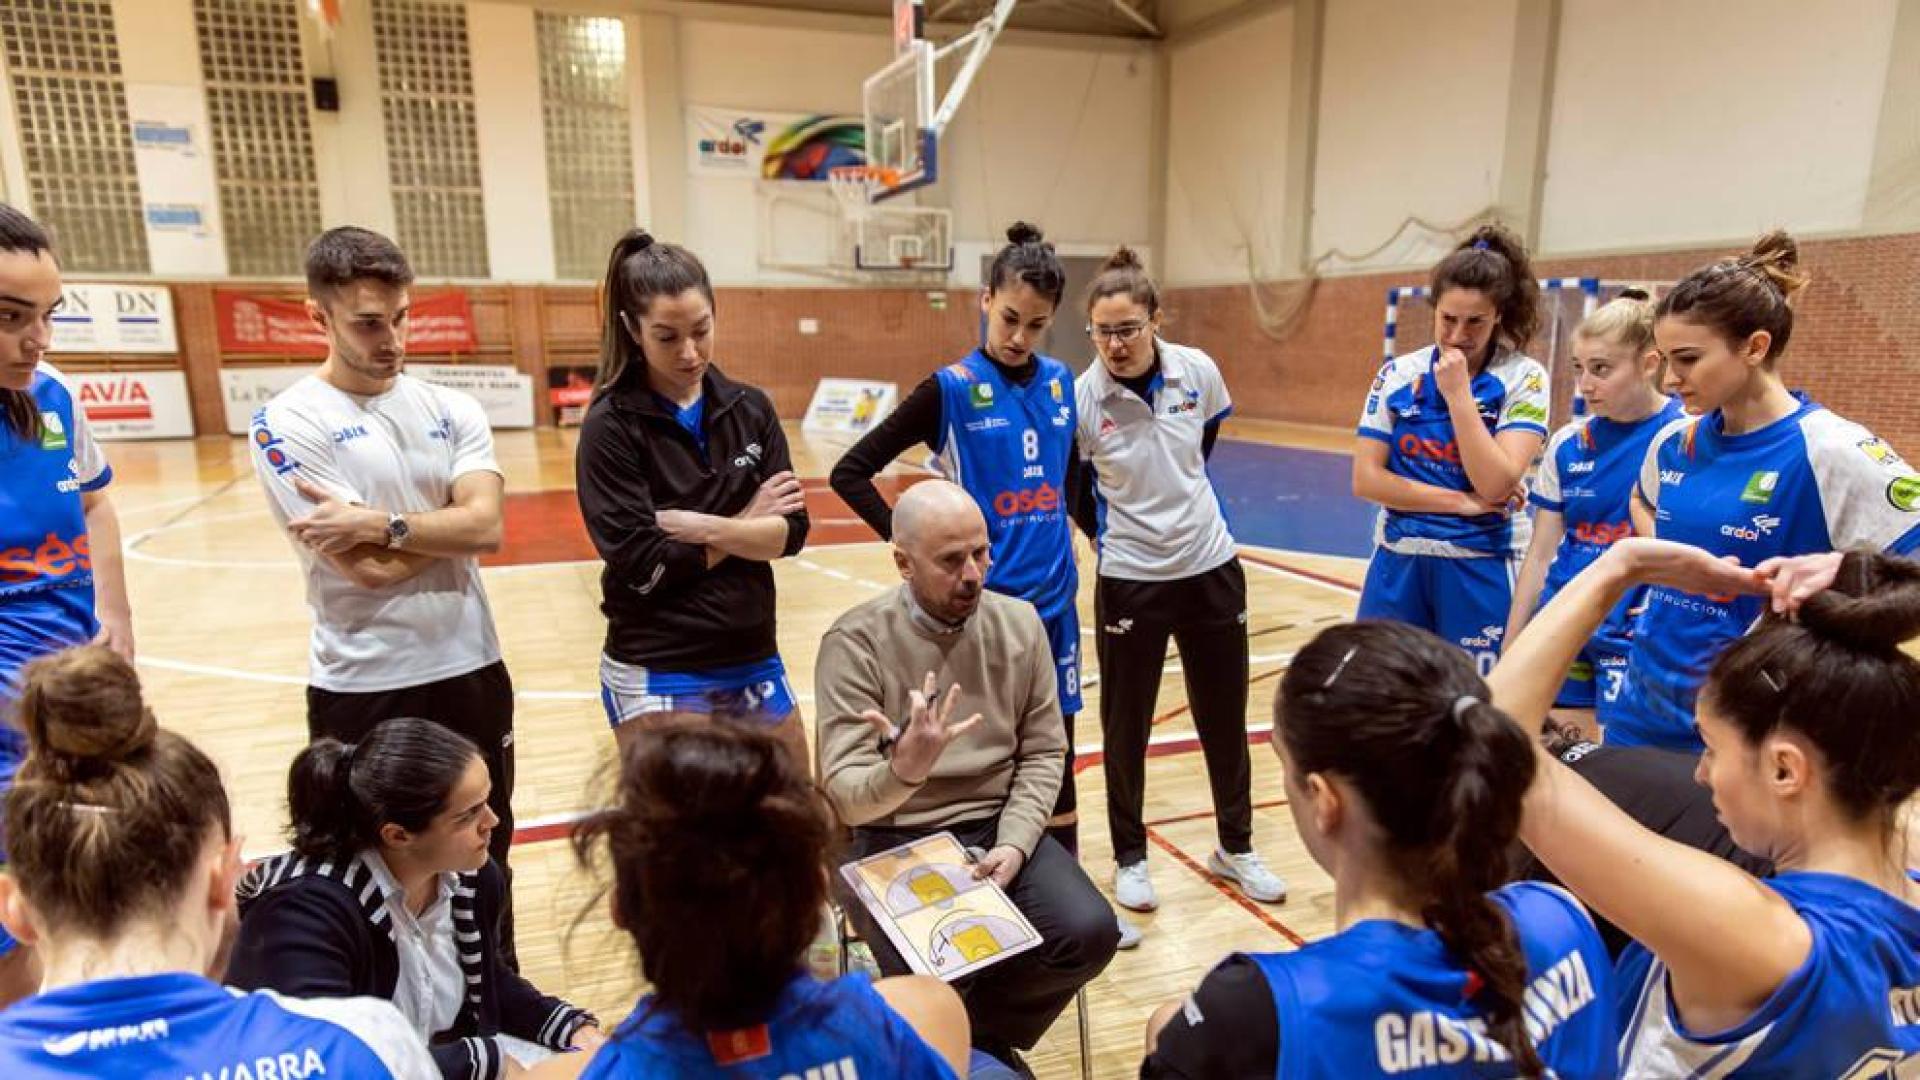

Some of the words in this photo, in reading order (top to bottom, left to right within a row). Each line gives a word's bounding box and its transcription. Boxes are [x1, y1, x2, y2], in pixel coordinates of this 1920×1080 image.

[115, 291, 158, 313] DN
[1022, 427, 1039, 462] 8
[1721, 524, 1759, 541] ardoi
[1065, 666, 1077, 696] 8
[1603, 668, 1624, 703] 3
